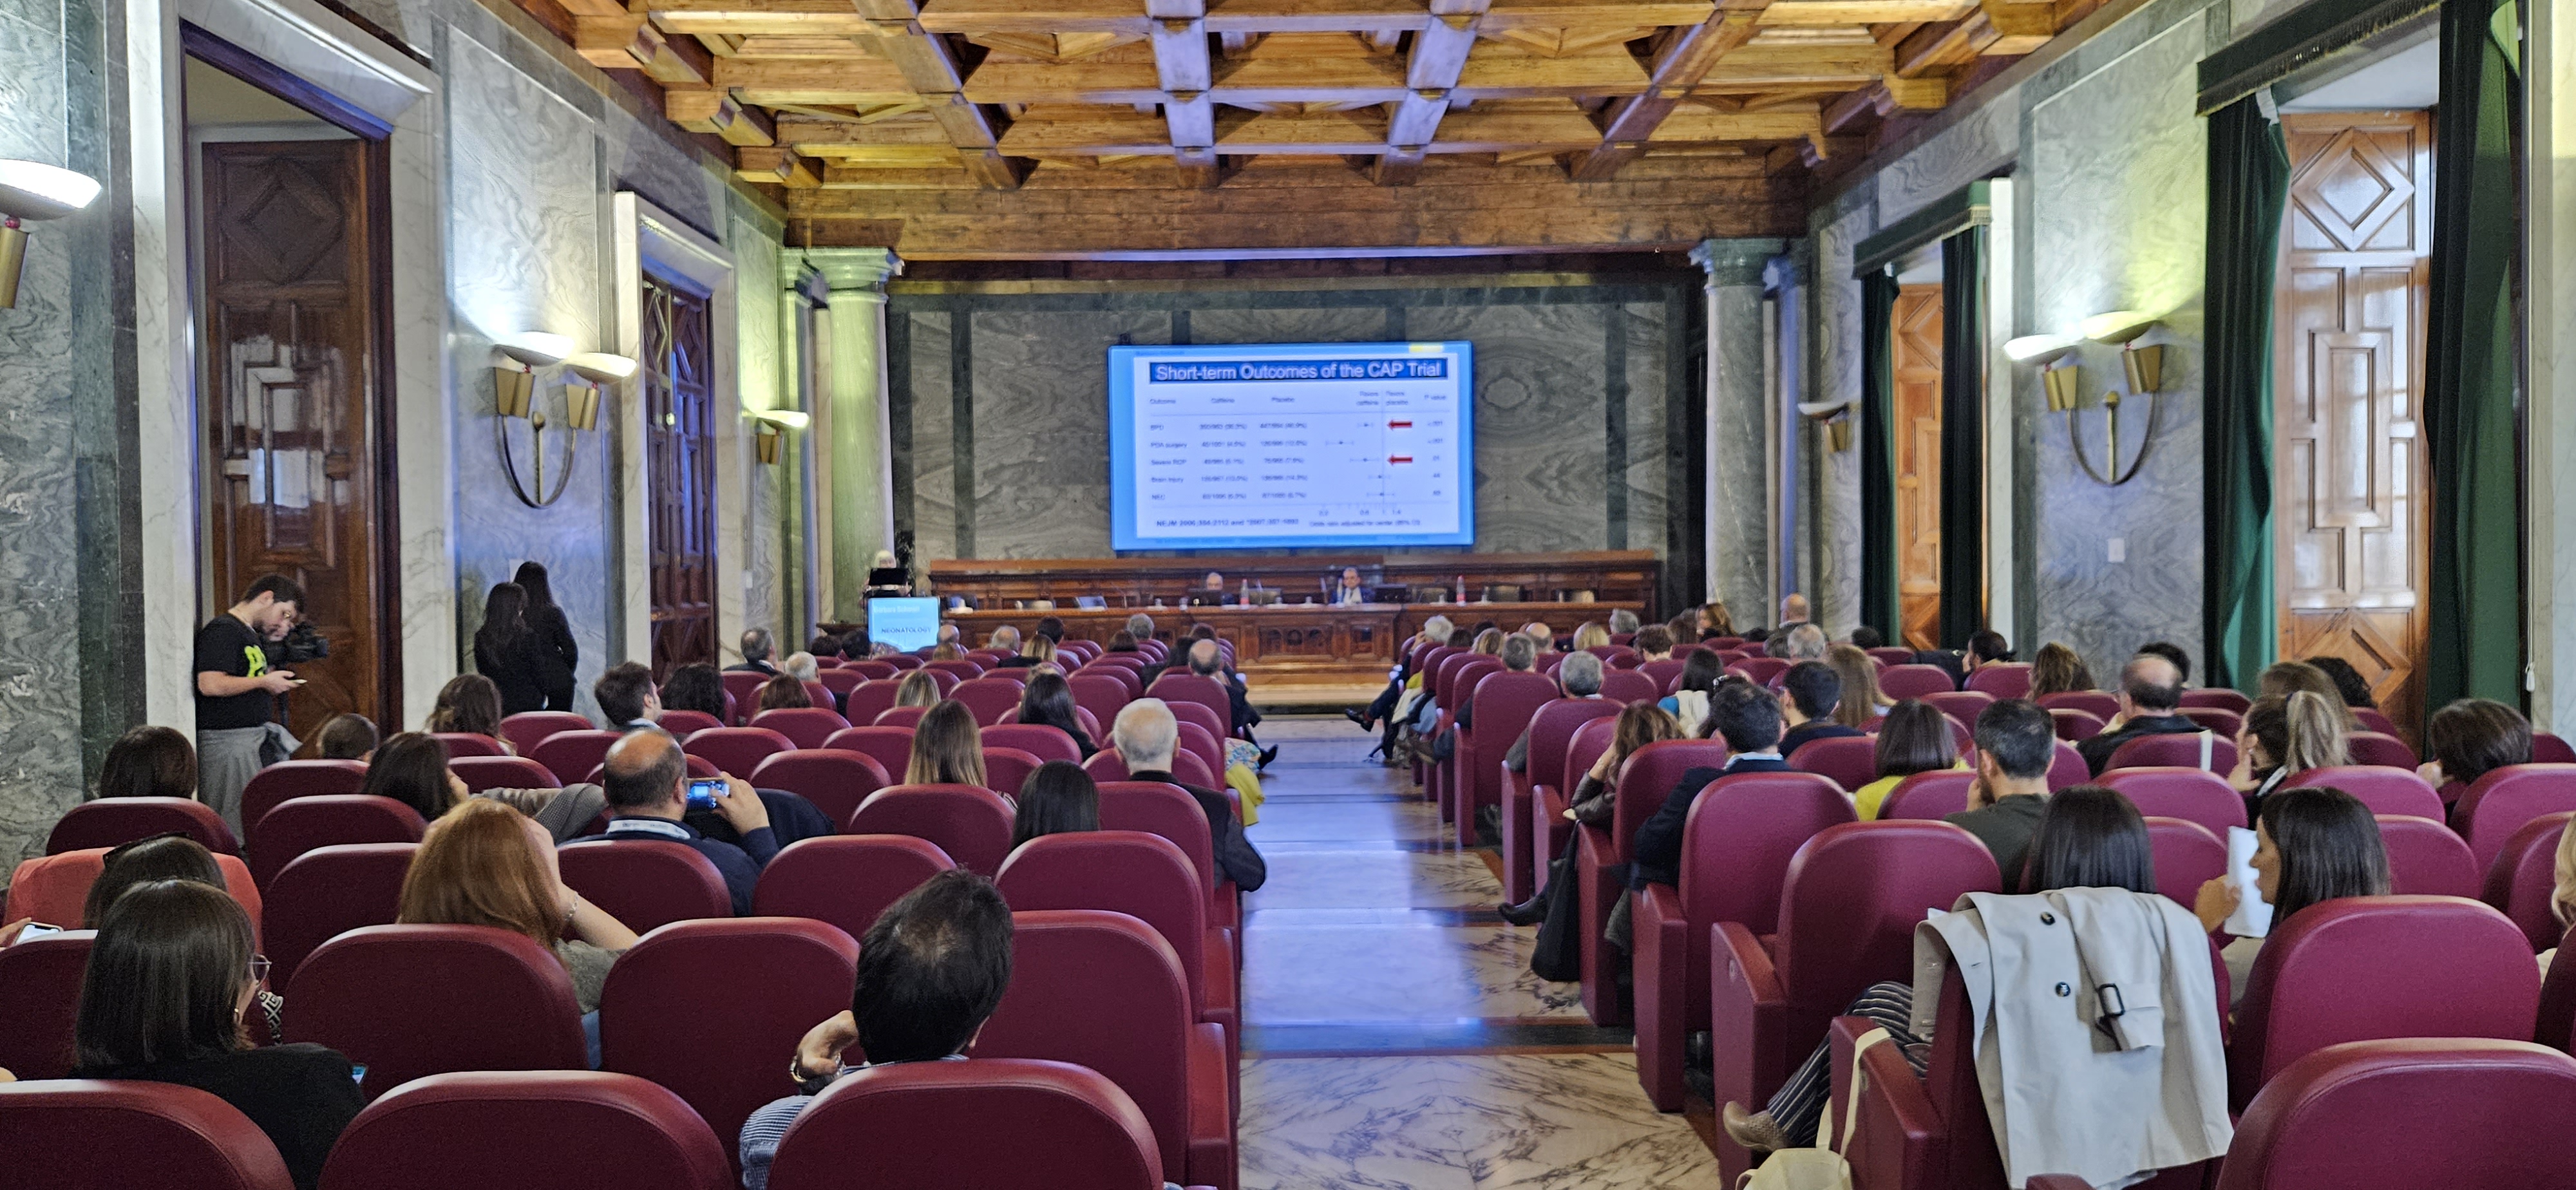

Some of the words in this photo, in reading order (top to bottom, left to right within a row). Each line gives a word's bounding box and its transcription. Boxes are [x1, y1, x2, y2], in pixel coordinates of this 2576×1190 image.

[1156, 364, 1237, 381] Short-term
[1240, 361, 1318, 380] Outcomes
[1320, 361, 1338, 379] of
[1339, 361, 1365, 379] the
[1367, 359, 1404, 378] CAP
[1406, 359, 1443, 377] Trial
